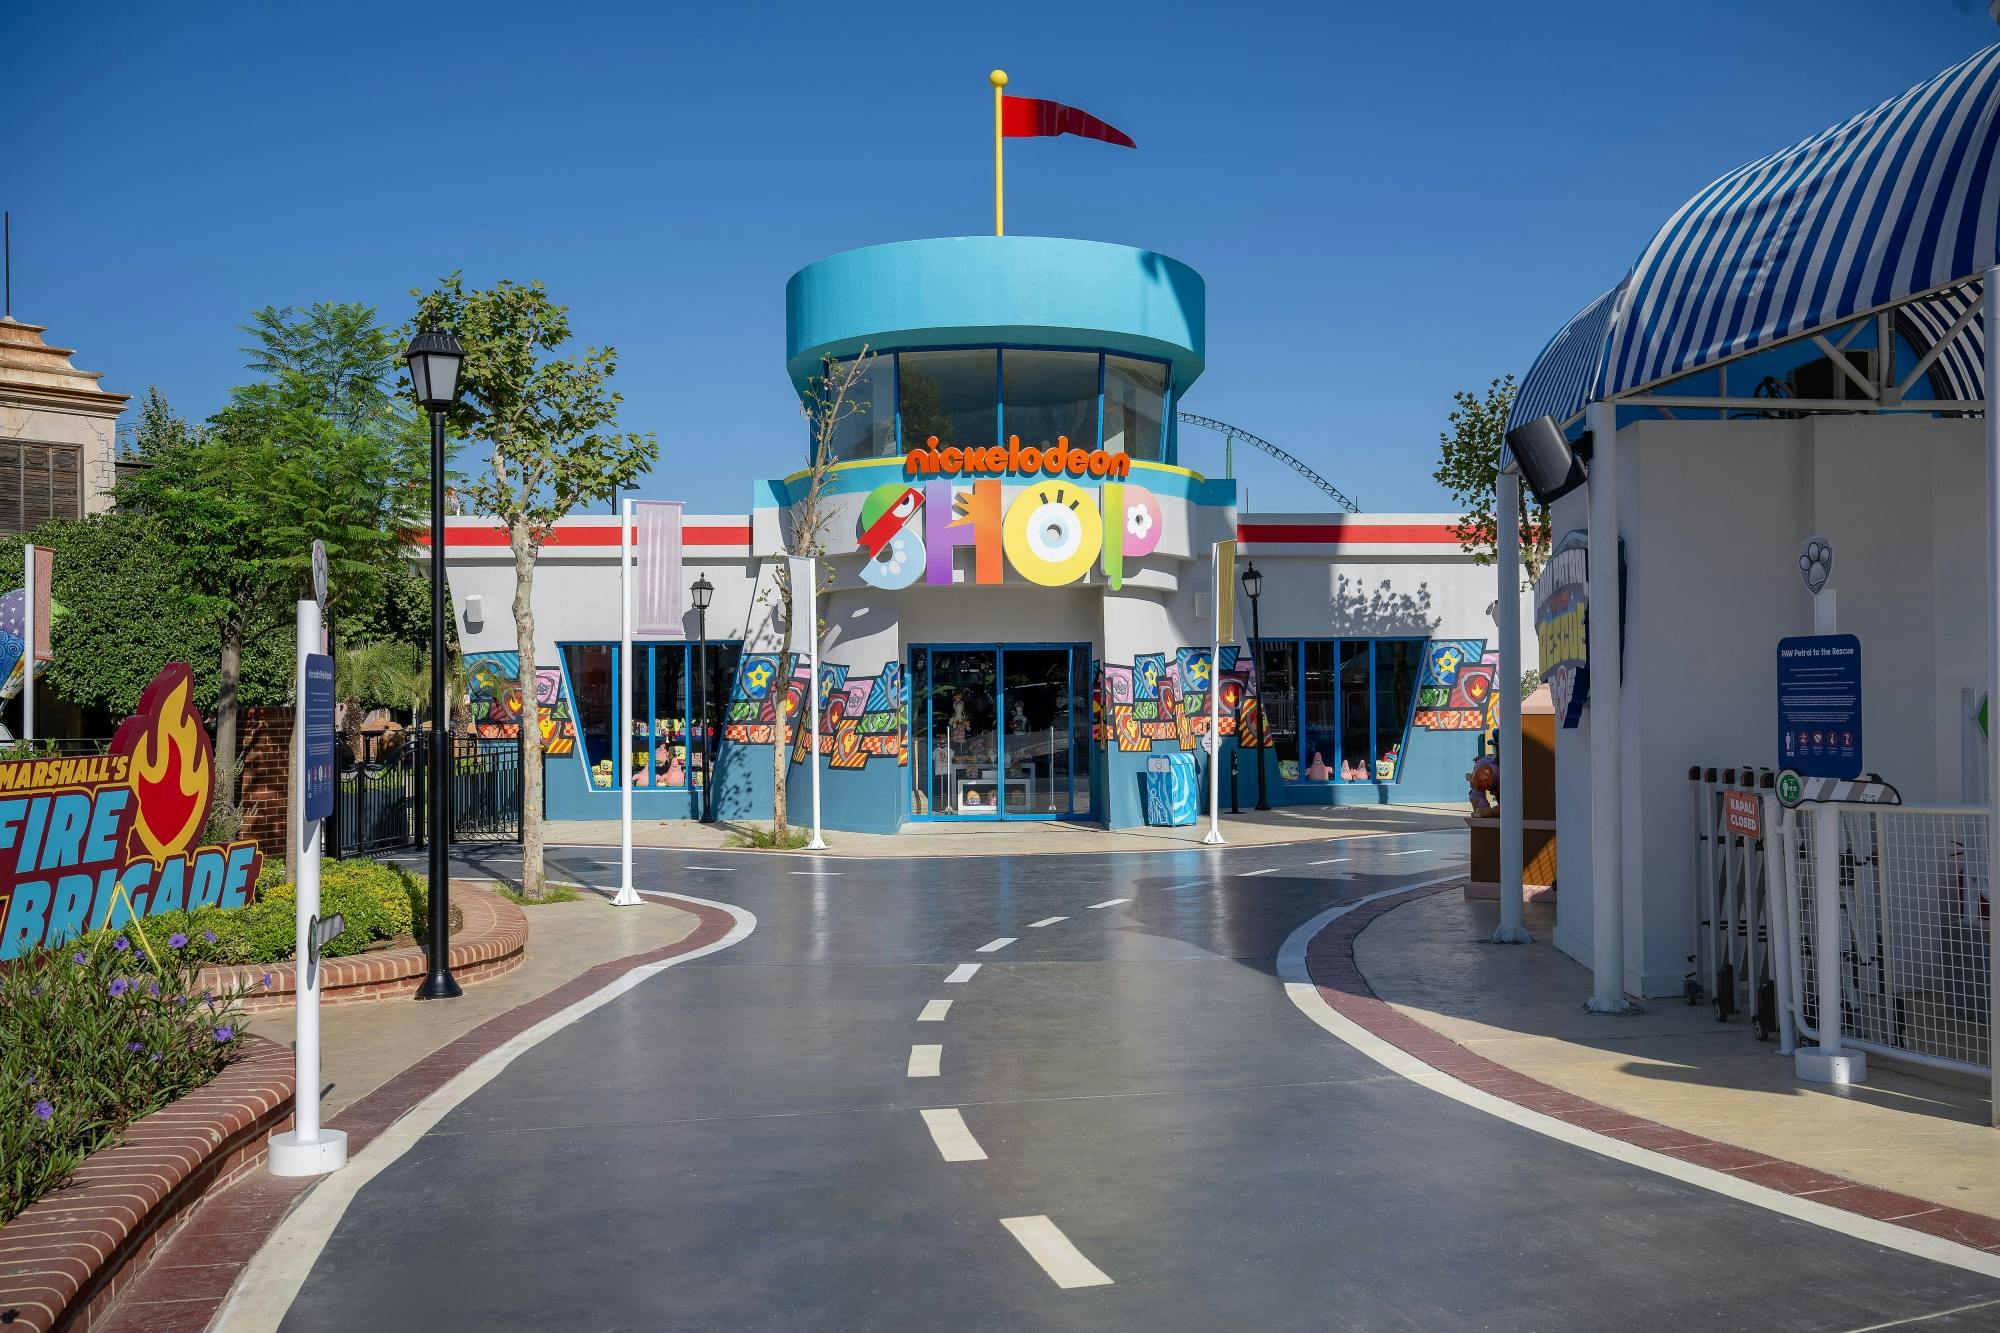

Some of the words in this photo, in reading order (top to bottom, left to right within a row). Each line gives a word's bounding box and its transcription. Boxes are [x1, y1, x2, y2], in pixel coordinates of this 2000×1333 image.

[906, 434, 1131, 477] nickelodeon
[857, 479, 1163, 591] SHOP
[1539, 602, 1587, 675] RESCUE
[1813, 648, 1820, 656] to
[1820, 648, 1831, 656] the
[1832, 647, 1854, 655] Rescue
[0, 755, 129, 790] MARSHALL'S
[1730, 798, 1755, 815] KAPALI
[1730, 813, 1757, 831] CLOSED
[0, 789, 130, 874] FIRE
[0, 846, 256, 961] BRIGADE
